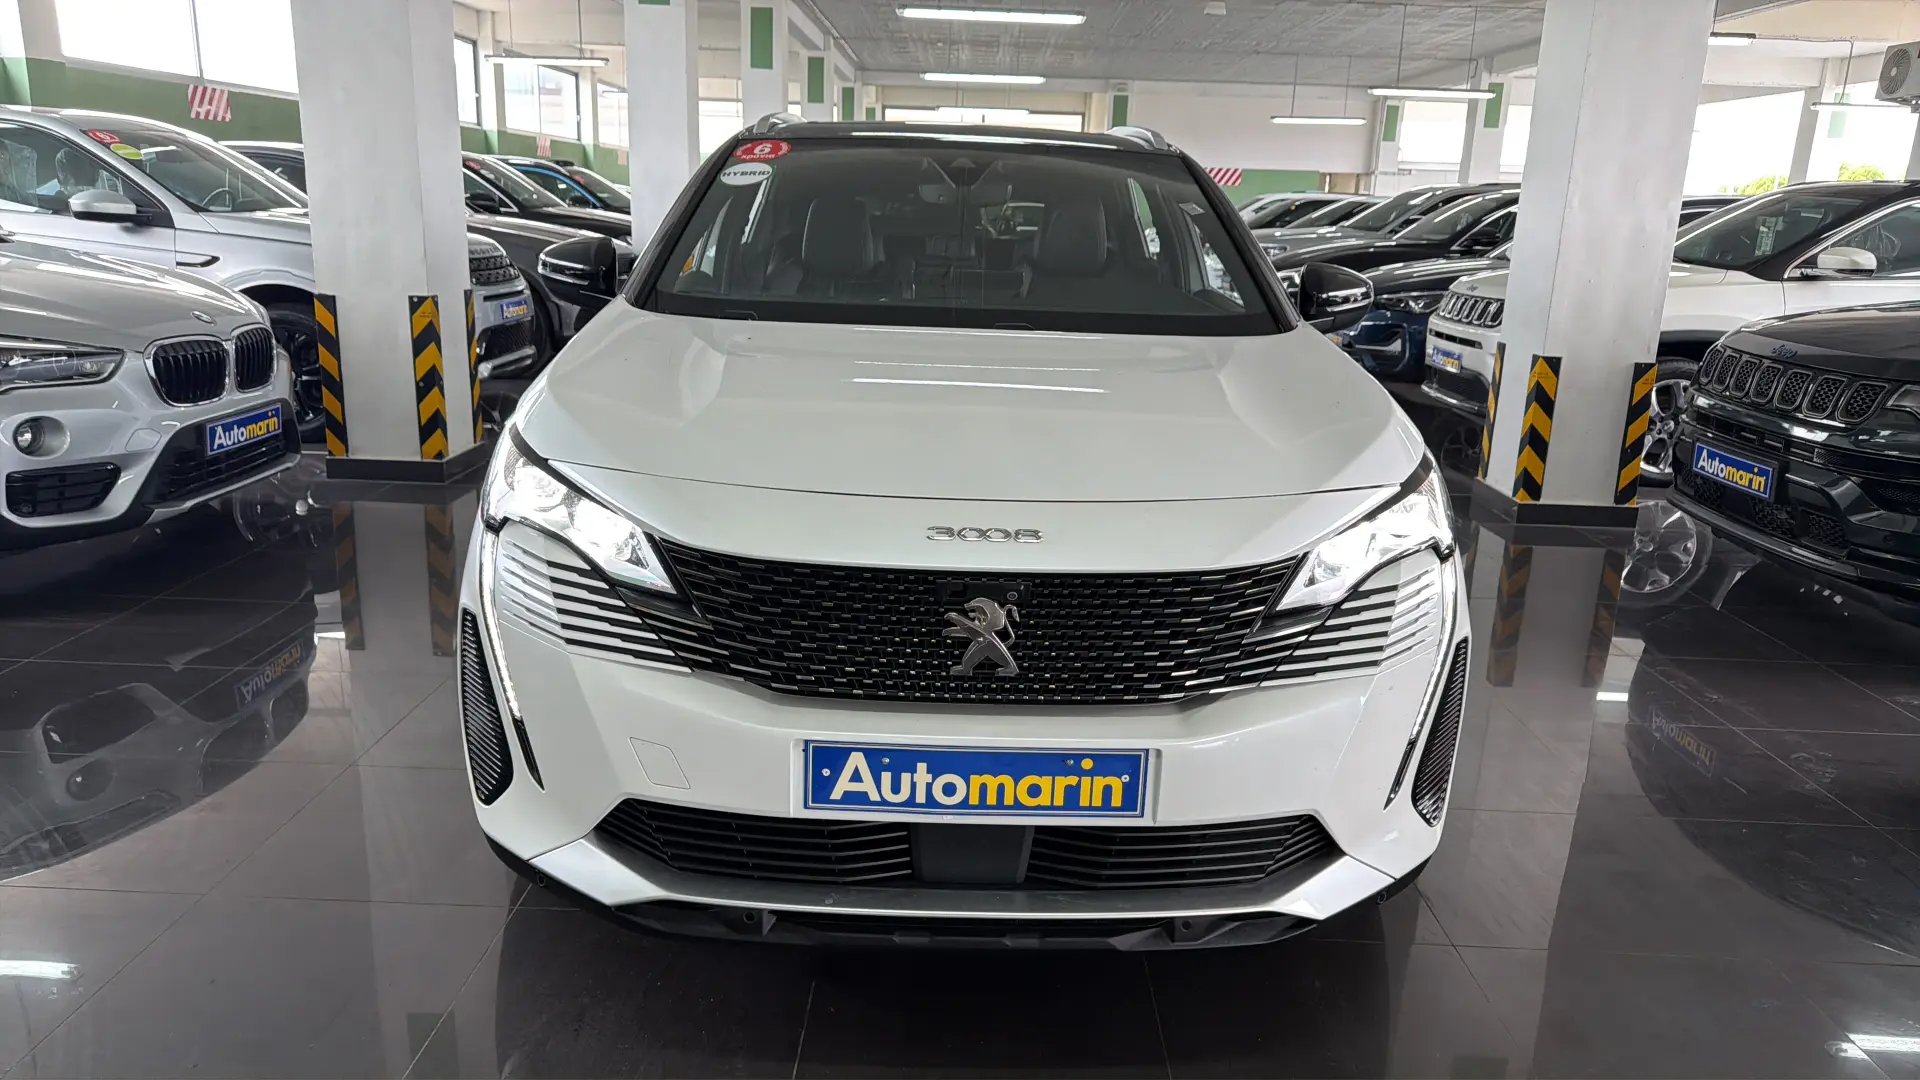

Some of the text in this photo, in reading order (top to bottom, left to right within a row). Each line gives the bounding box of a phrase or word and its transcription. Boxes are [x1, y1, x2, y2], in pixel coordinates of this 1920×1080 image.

[753, 143, 773, 155] 6
[213, 411, 278, 450] Automarin
[1697, 448, 1766, 493] Automarin
[926, 526, 1045, 543] 3008
[829, 751, 1123, 807] Automarin
